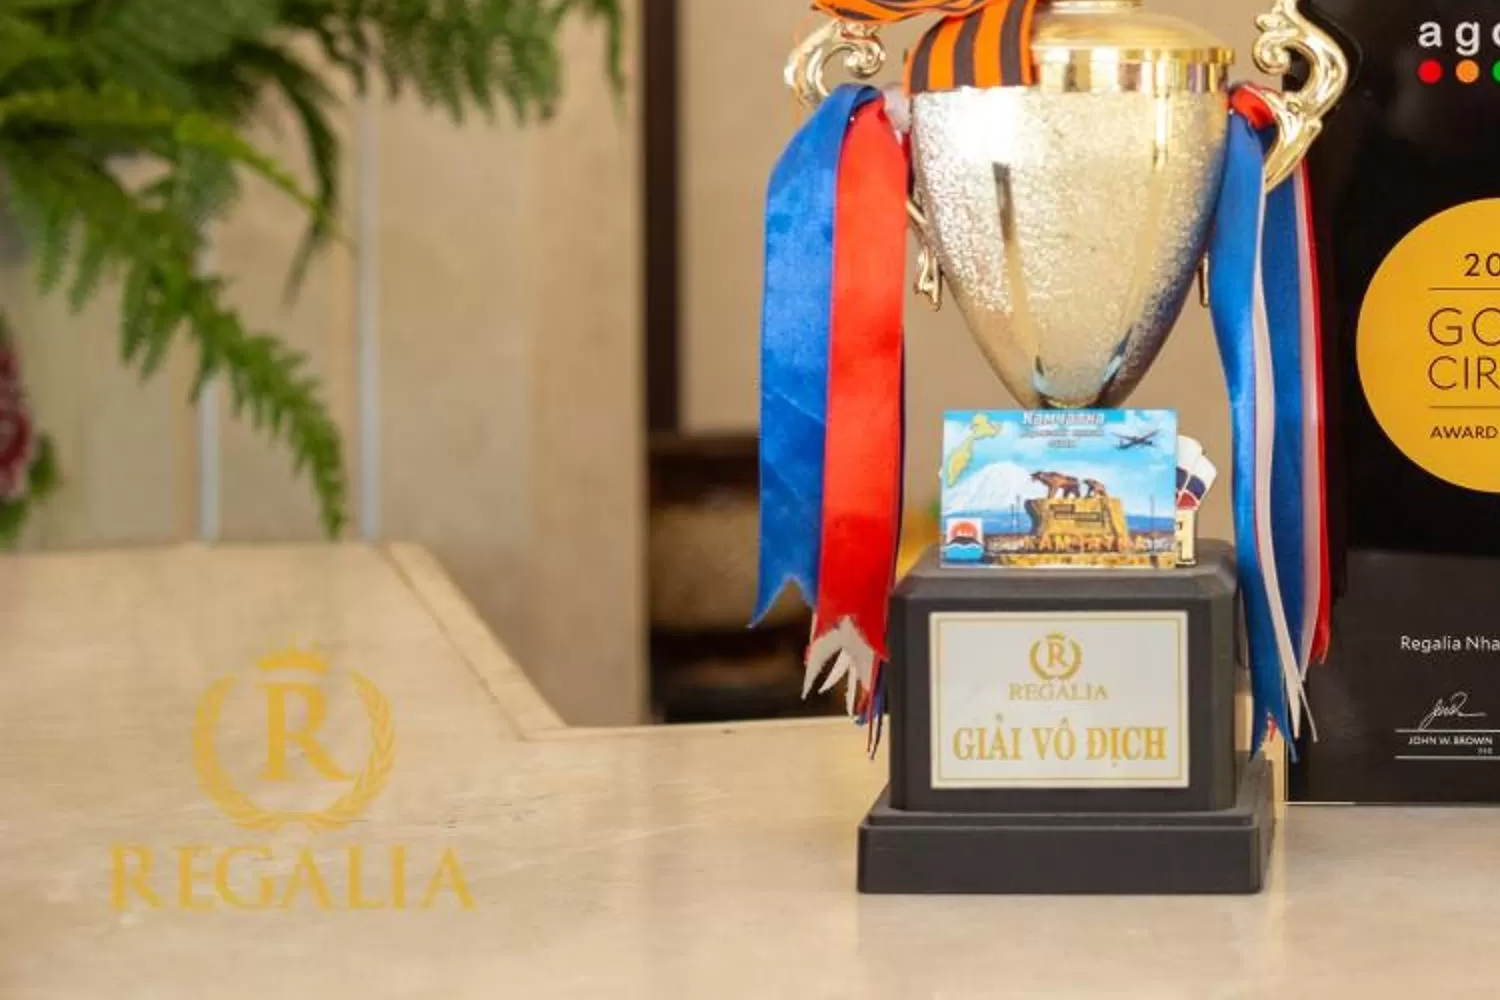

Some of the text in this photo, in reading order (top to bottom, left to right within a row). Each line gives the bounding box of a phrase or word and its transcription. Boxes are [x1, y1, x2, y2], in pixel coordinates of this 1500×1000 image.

[1429, 425, 1498, 440] AWARD
[1400, 635, 1462, 655] Regalia
[1465, 635, 1500, 651] Nha
[1009, 683, 1109, 701] REGALIA
[1408, 736, 1437, 745] JOHN
[1453, 736, 1493, 745] BROWN
